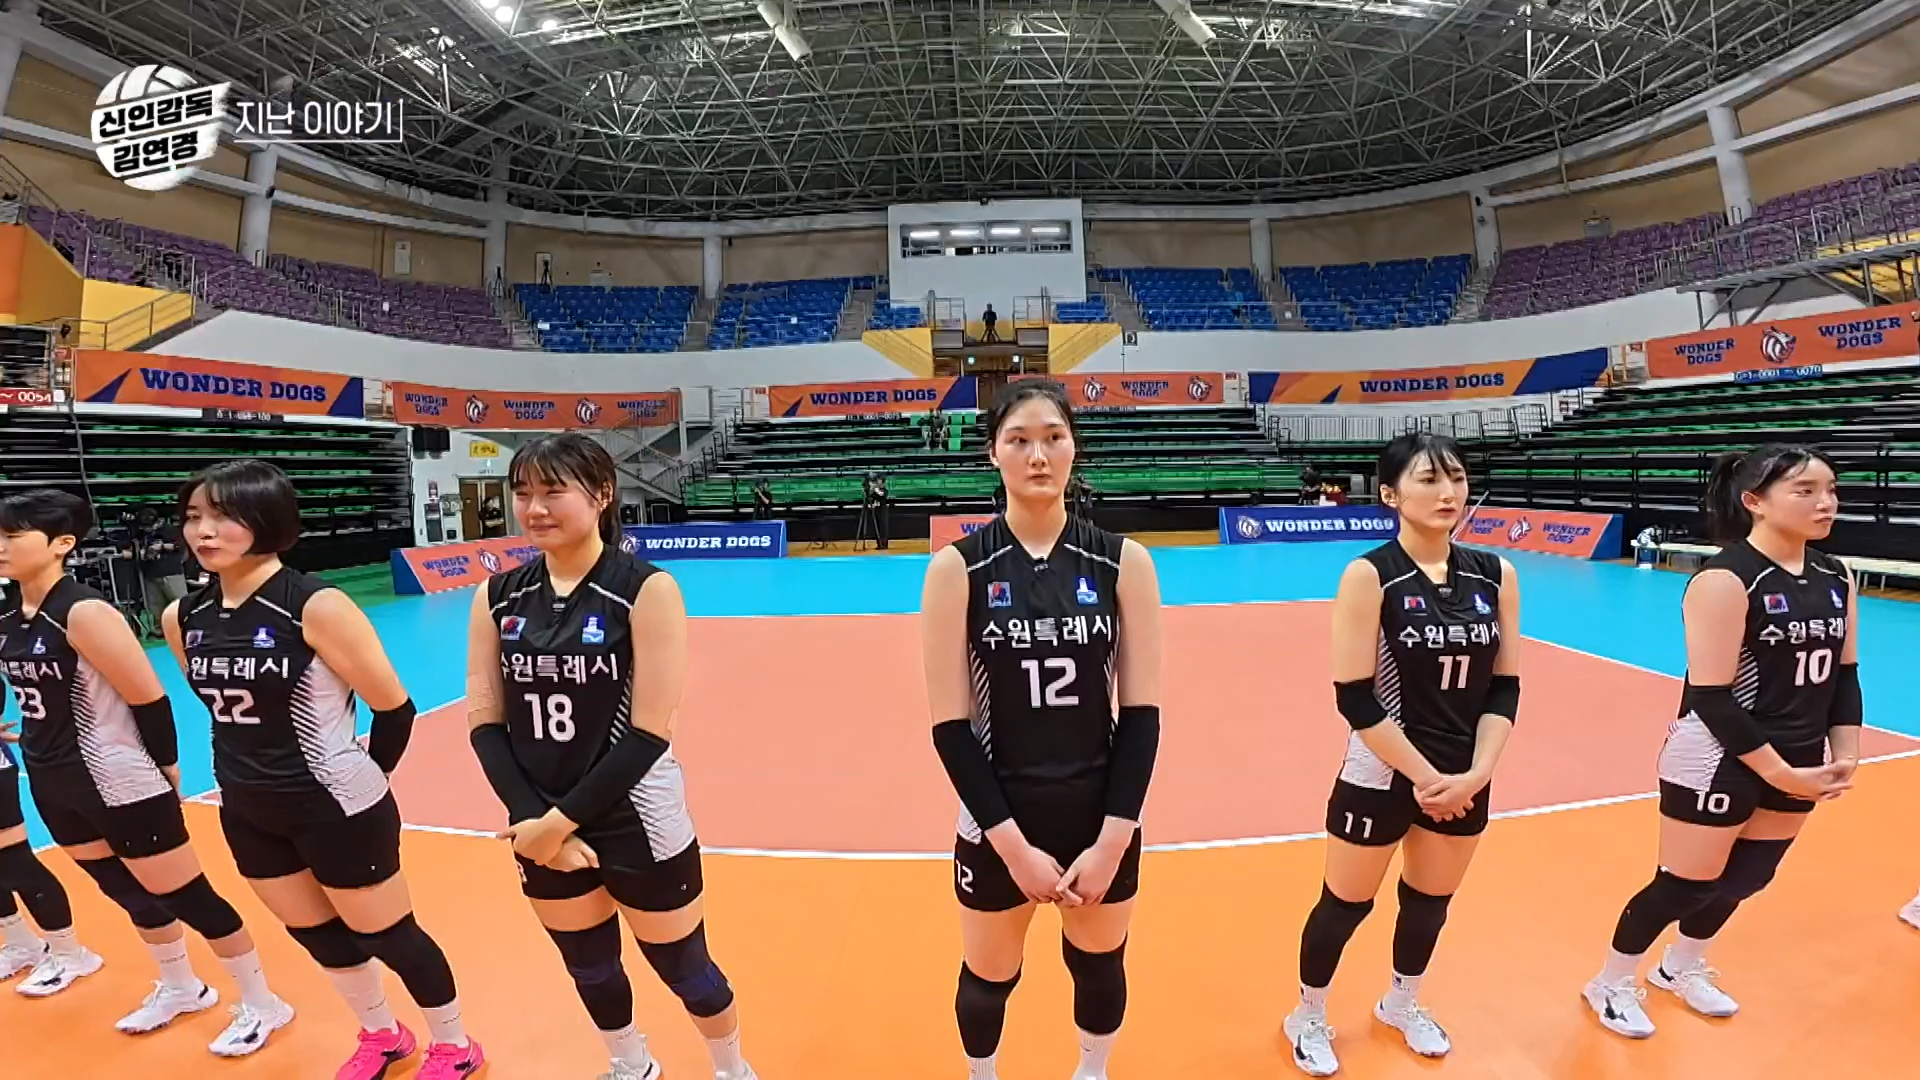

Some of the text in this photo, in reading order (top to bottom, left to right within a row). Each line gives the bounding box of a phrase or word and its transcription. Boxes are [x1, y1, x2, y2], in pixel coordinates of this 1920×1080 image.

[1818, 316, 1902, 338] WONDER
[1674, 338, 1735, 356] WONDER
[1836, 331, 1883, 350] DOGS
[1687, 353, 1722, 366] DOGS
[139, 368, 326, 402] WONDER DOGS
[1121, 381, 1169, 390] WONDER
[1359, 373, 1505, 393] WONDER DOGS
[405, 392, 449, 407] WONDER
[504, 399, 555, 410] WONDER
[810, 388, 937, 407] WONDER DOGS
[515, 410, 545, 420] DOGS
[1265, 519, 1346, 532] WONDER
[1543, 522, 1591, 536] WONDER
[645, 535, 772, 550] WONDER DOGS
[982, 615, 1112, 650] 수원특례시
[1438, 655, 1471, 690] 11
[1794, 649, 1833, 686] 10
[1021, 657, 1080, 708] 12
[11, 686, 47, 719] 23
[198, 688, 260, 724] 22
[524, 693, 576, 742] 18
[1695, 791, 1731, 814] 10
[1344, 811, 1373, 838] 11
[956, 859, 974, 894] 12
